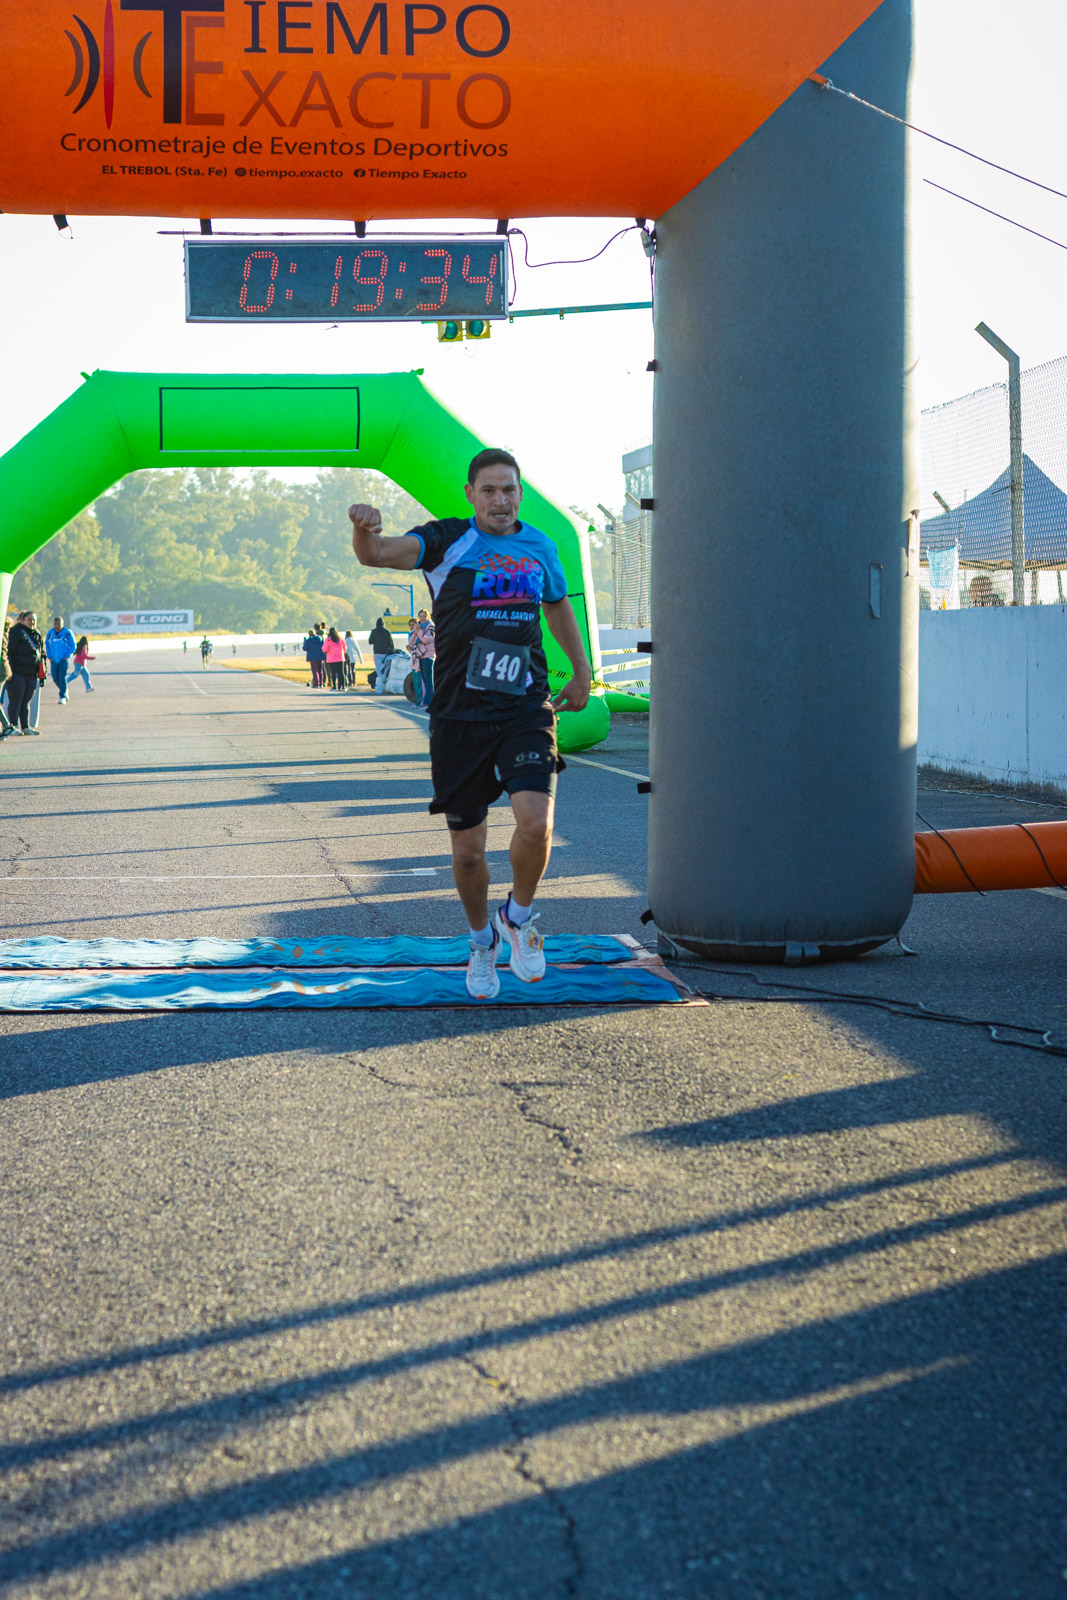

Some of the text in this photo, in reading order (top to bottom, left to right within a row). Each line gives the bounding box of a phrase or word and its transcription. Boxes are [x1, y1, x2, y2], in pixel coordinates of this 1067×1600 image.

[60, 132, 508, 160] Cronometraje de Eventos Deportivos
[102, 165, 467, 180] EL TREBOL (Sta. Fe) tiempo.exacto Tiempo Exacto
[472, 571, 541, 599] RUN
[139, 614, 184, 623] LONG
[476, 609, 508, 620] RAFAELA,
[481, 651, 521, 682] 140
